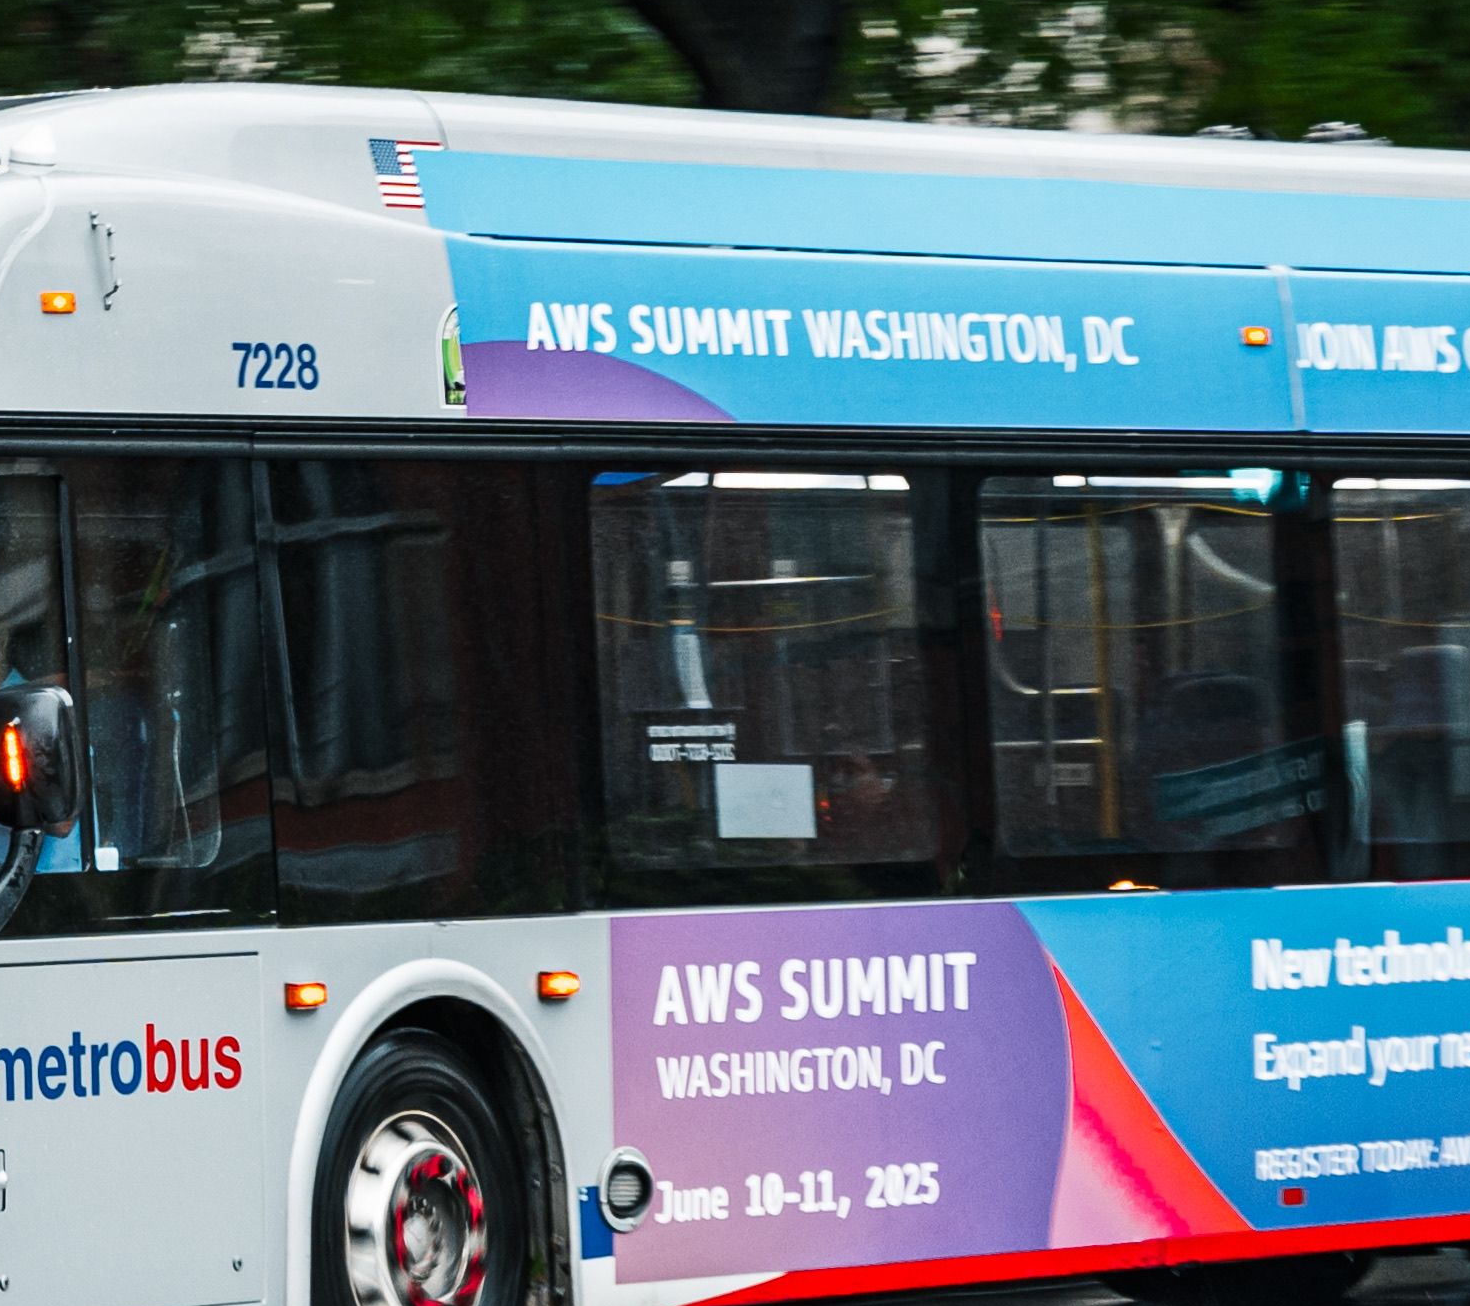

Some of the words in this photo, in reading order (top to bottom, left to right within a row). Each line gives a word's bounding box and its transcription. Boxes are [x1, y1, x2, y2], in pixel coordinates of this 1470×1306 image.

[232, 342, 319, 391] 7228
[527, 302, 617, 354] AWS
[628, 304, 792, 357] SUMMIT
[802, 309, 1077, 373] WASHINGTON,
[1082, 316, 1140, 366] DC
[1296, 322, 1377, 371] JOIN
[1382, 325, 1460, 373] AWS
[653, 960, 763, 1025] AWS
[779, 952, 977, 1021] SUMMIT
[1252, 939, 1332, 990] New
[656, 1045, 892, 1099] WASHINGTON,
[900, 1041, 947, 1086] DC
[1253, 1025, 1366, 1091] Expand
[1367, 1035, 1439, 1086] your
[1255, 1143, 1359, 1181] REGISTER
[654, 1181, 730, 1224] June
[865, 1162, 940, 1209] 2025
